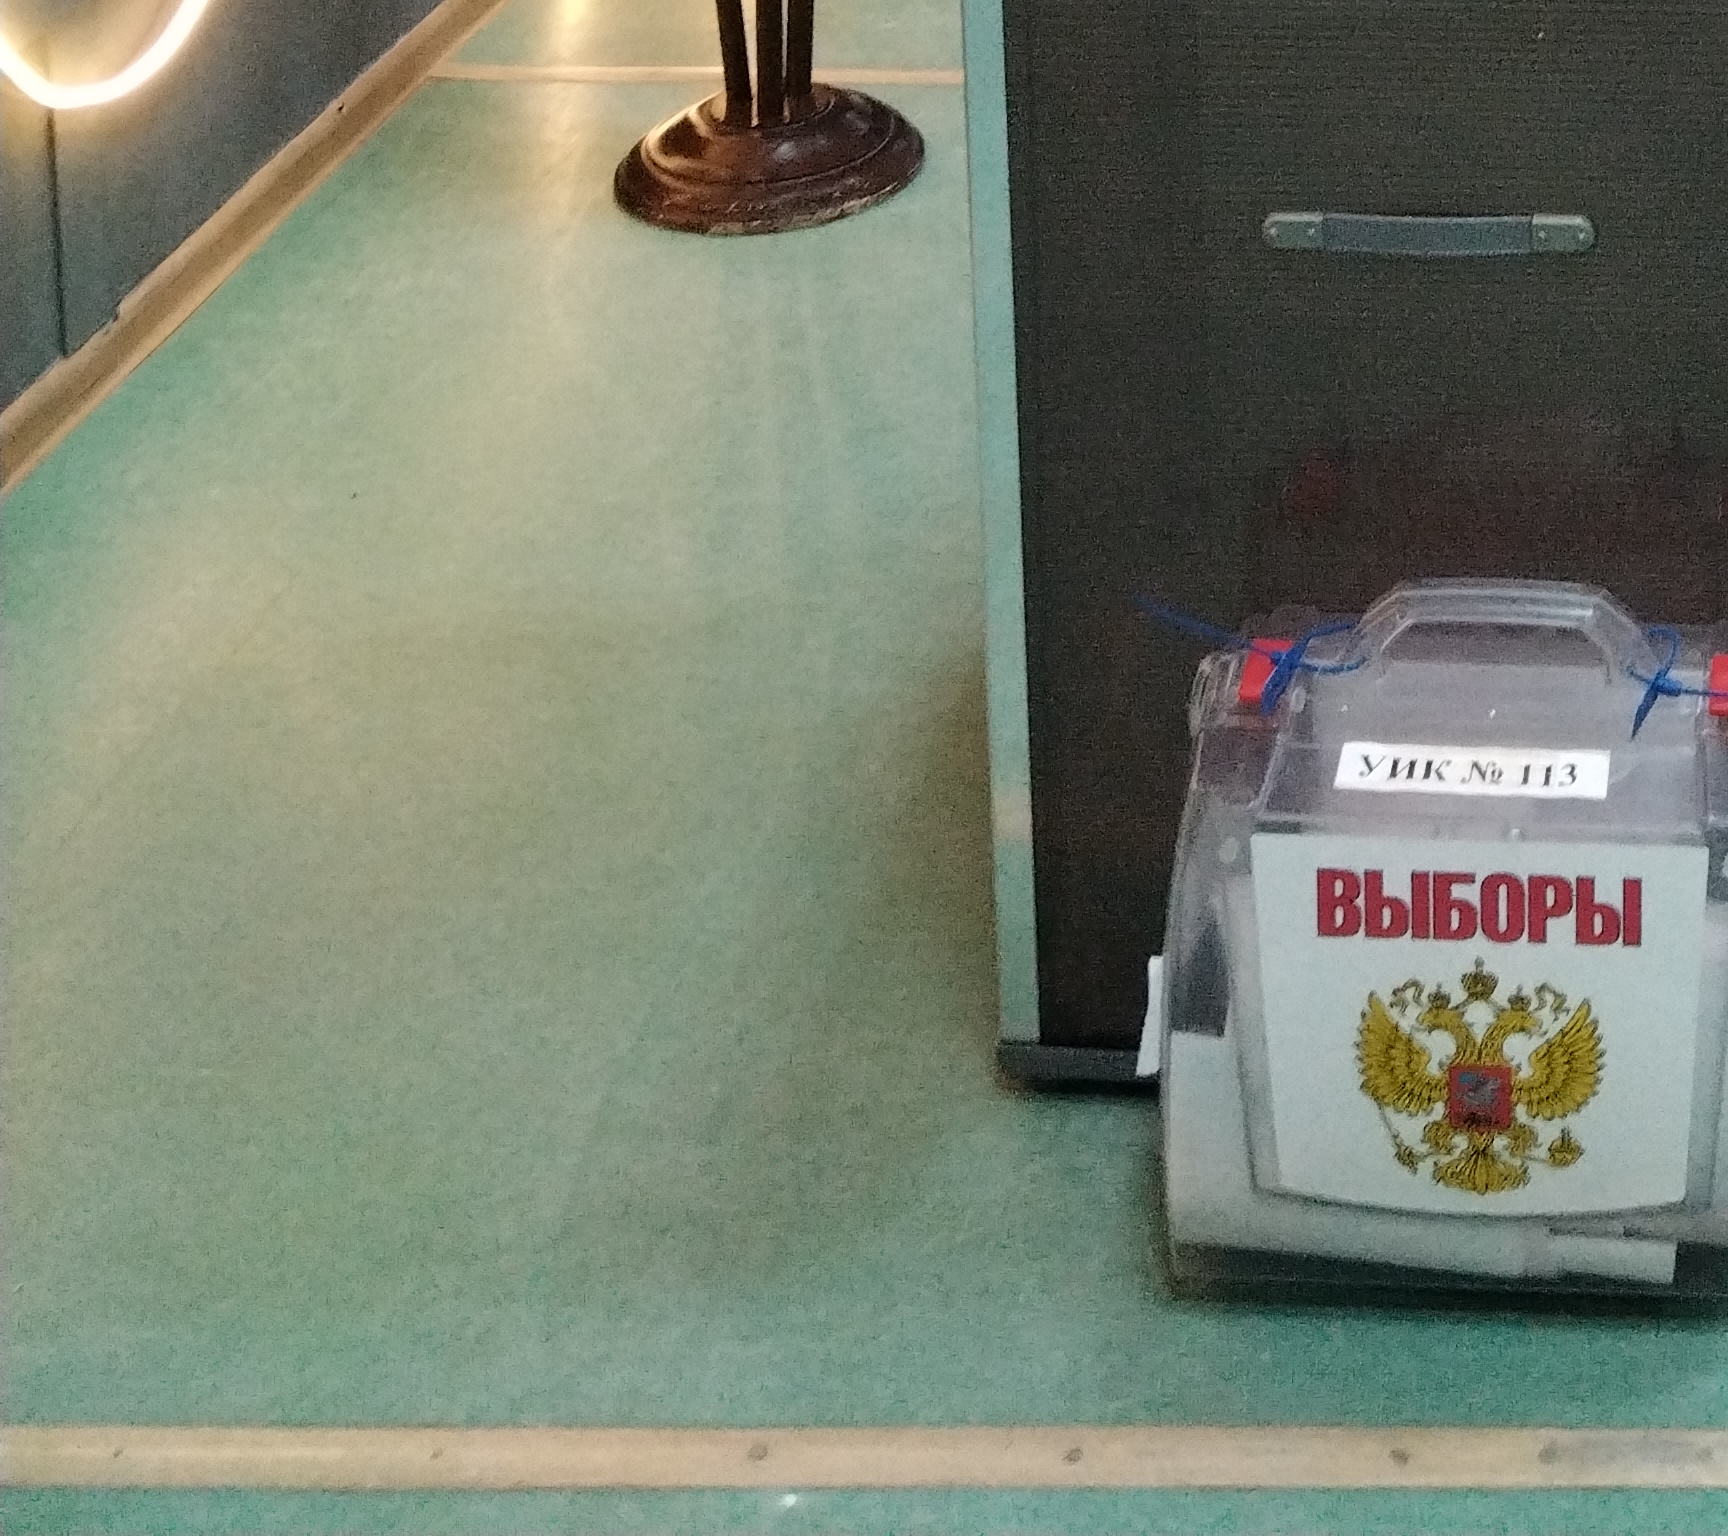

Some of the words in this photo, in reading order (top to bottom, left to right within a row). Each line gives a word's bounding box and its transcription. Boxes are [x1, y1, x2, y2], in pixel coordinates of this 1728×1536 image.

[1358, 754, 1453, 781] УИК
[1460, 759, 1504, 785] №
[1519, 763, 1578, 788] 113
[1316, 867, 1642, 946] ВЫБОРЫ
